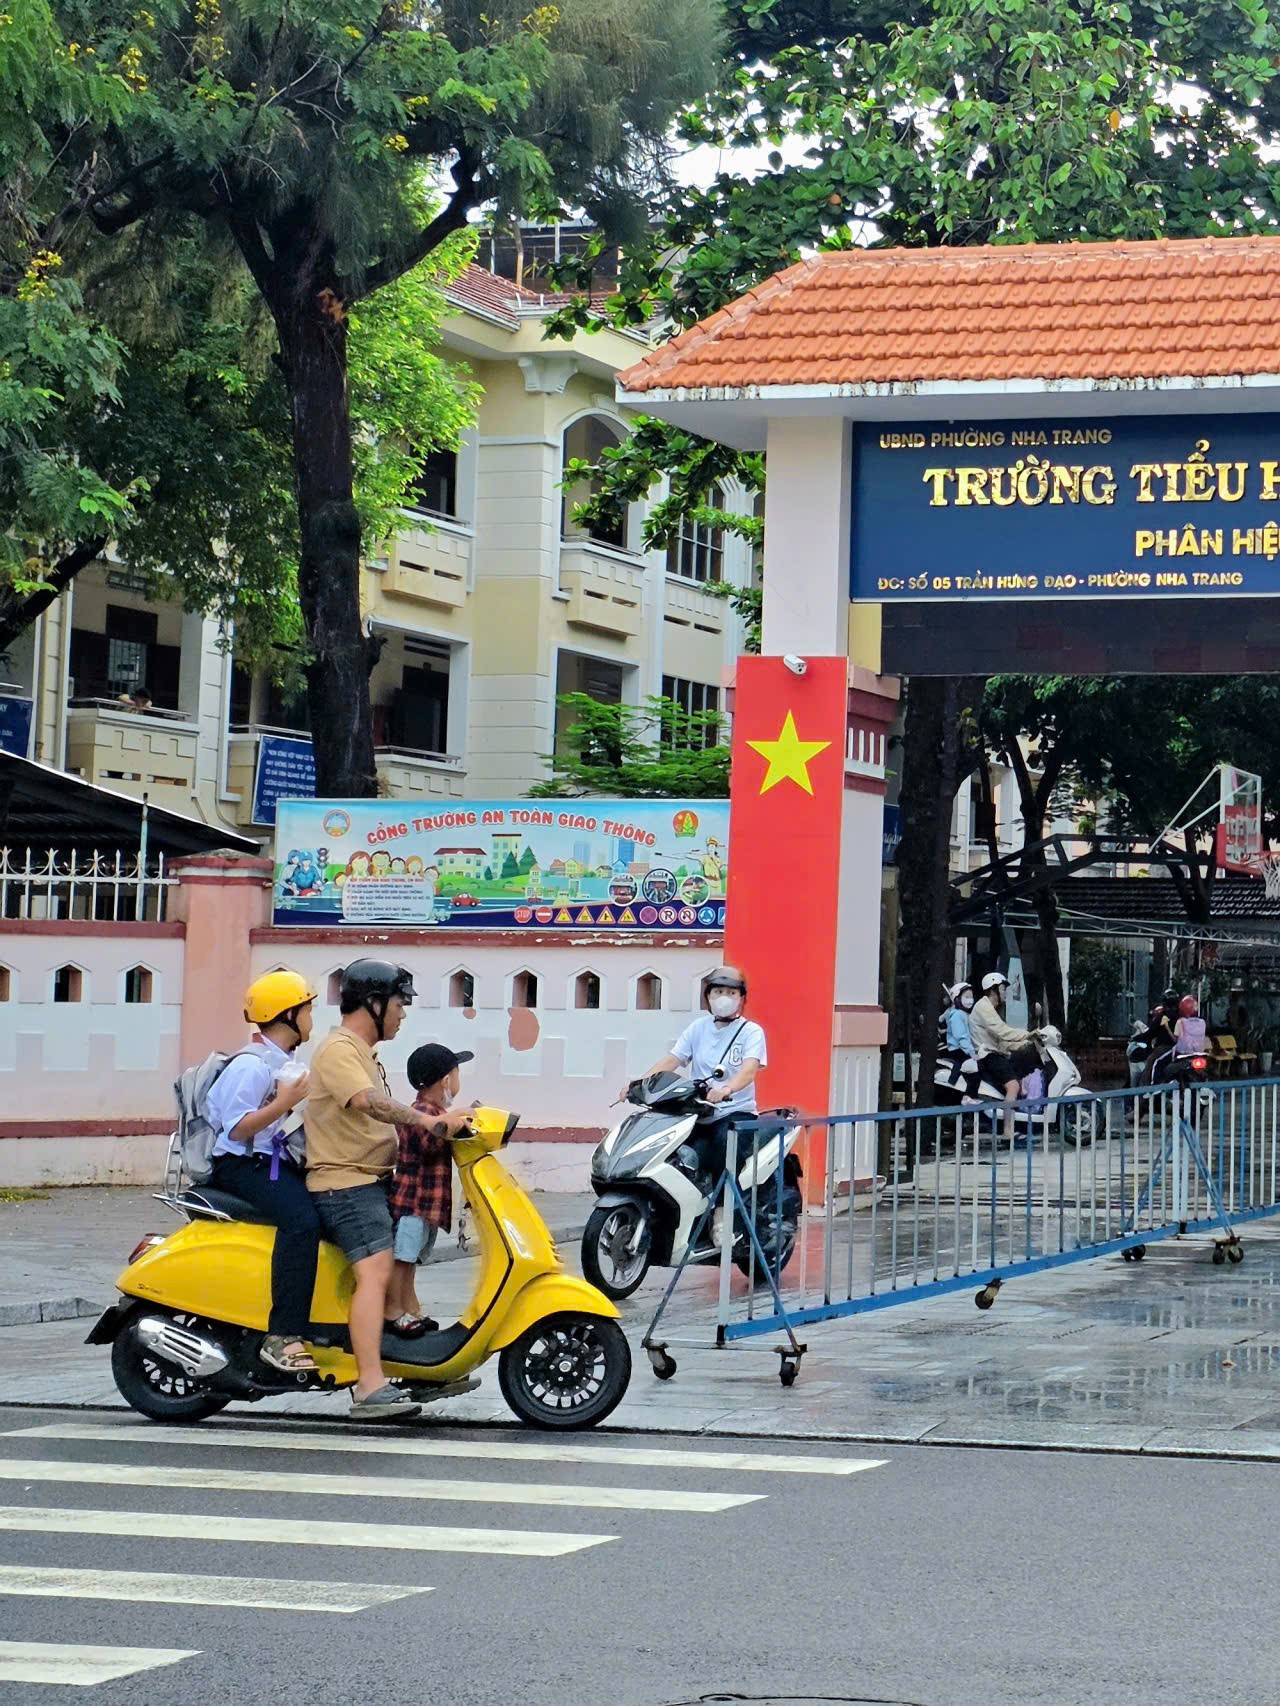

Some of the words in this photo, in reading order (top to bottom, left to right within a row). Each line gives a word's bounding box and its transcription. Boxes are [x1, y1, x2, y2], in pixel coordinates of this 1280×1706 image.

[879, 433, 926, 449] UBND
[931, 427, 1006, 448] PHƯỜNG
[1011, 430, 1048, 446] NHA
[1052, 429, 1112, 445] TRANG
[922, 453, 1118, 507] TRƯỜNG
[1129, 439, 1249, 502] TIỂU
[1134, 523, 1225, 558] PHÂN
[878, 577, 905, 590] ĐC:
[908, 571, 928, 590] SỐ
[932, 577, 952, 590] 05
[996, 574, 1039, 589] HƯNG
[1088, 570, 1152, 588] PHƯỜNG
[1155, 573, 1188, 587] NHA
[1192, 572, 1244, 586] TRANG
[366, 821, 409, 845] CỔNG
[411, 811, 477, 833] TRƯỜNG
[481, 810, 504, 824] AN
[509, 808, 553, 825] TOÀN
[558, 813, 597, 830] GIAO
[603, 820, 656, 846] THÔNG
